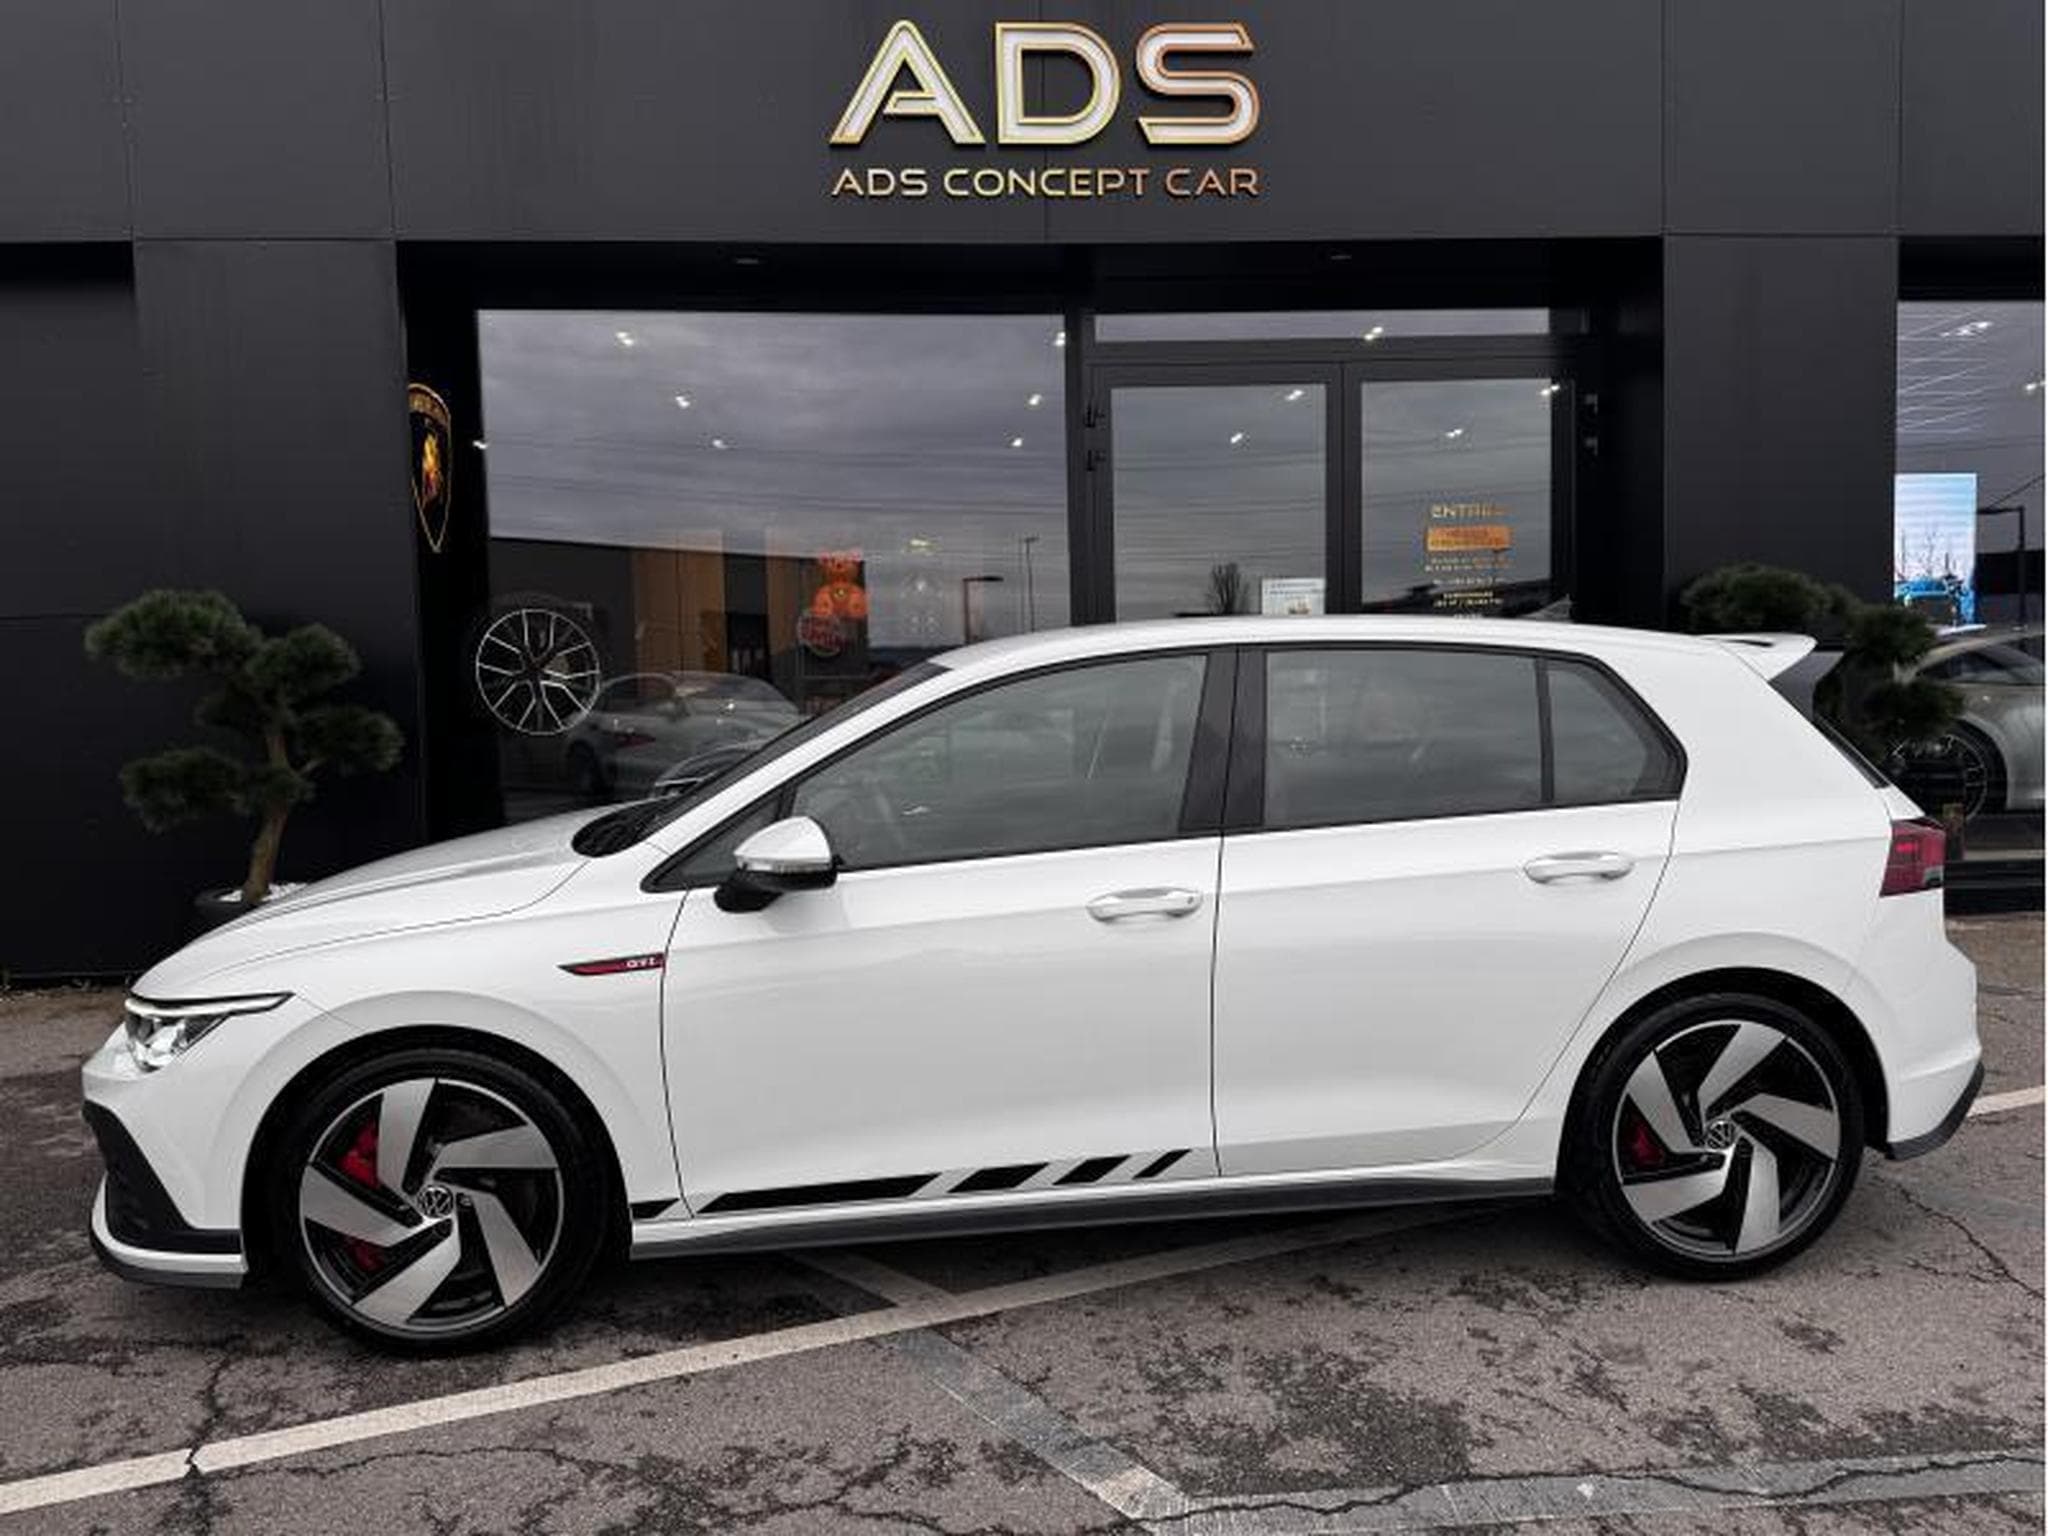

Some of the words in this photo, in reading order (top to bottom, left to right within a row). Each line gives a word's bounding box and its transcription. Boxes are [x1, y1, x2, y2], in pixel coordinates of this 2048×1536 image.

[829, 19, 1261, 145] ADS
[831, 168, 929, 197] ADS
[943, 168, 1150, 197] CONCEPT
[1165, 168, 1260, 197] CAR
